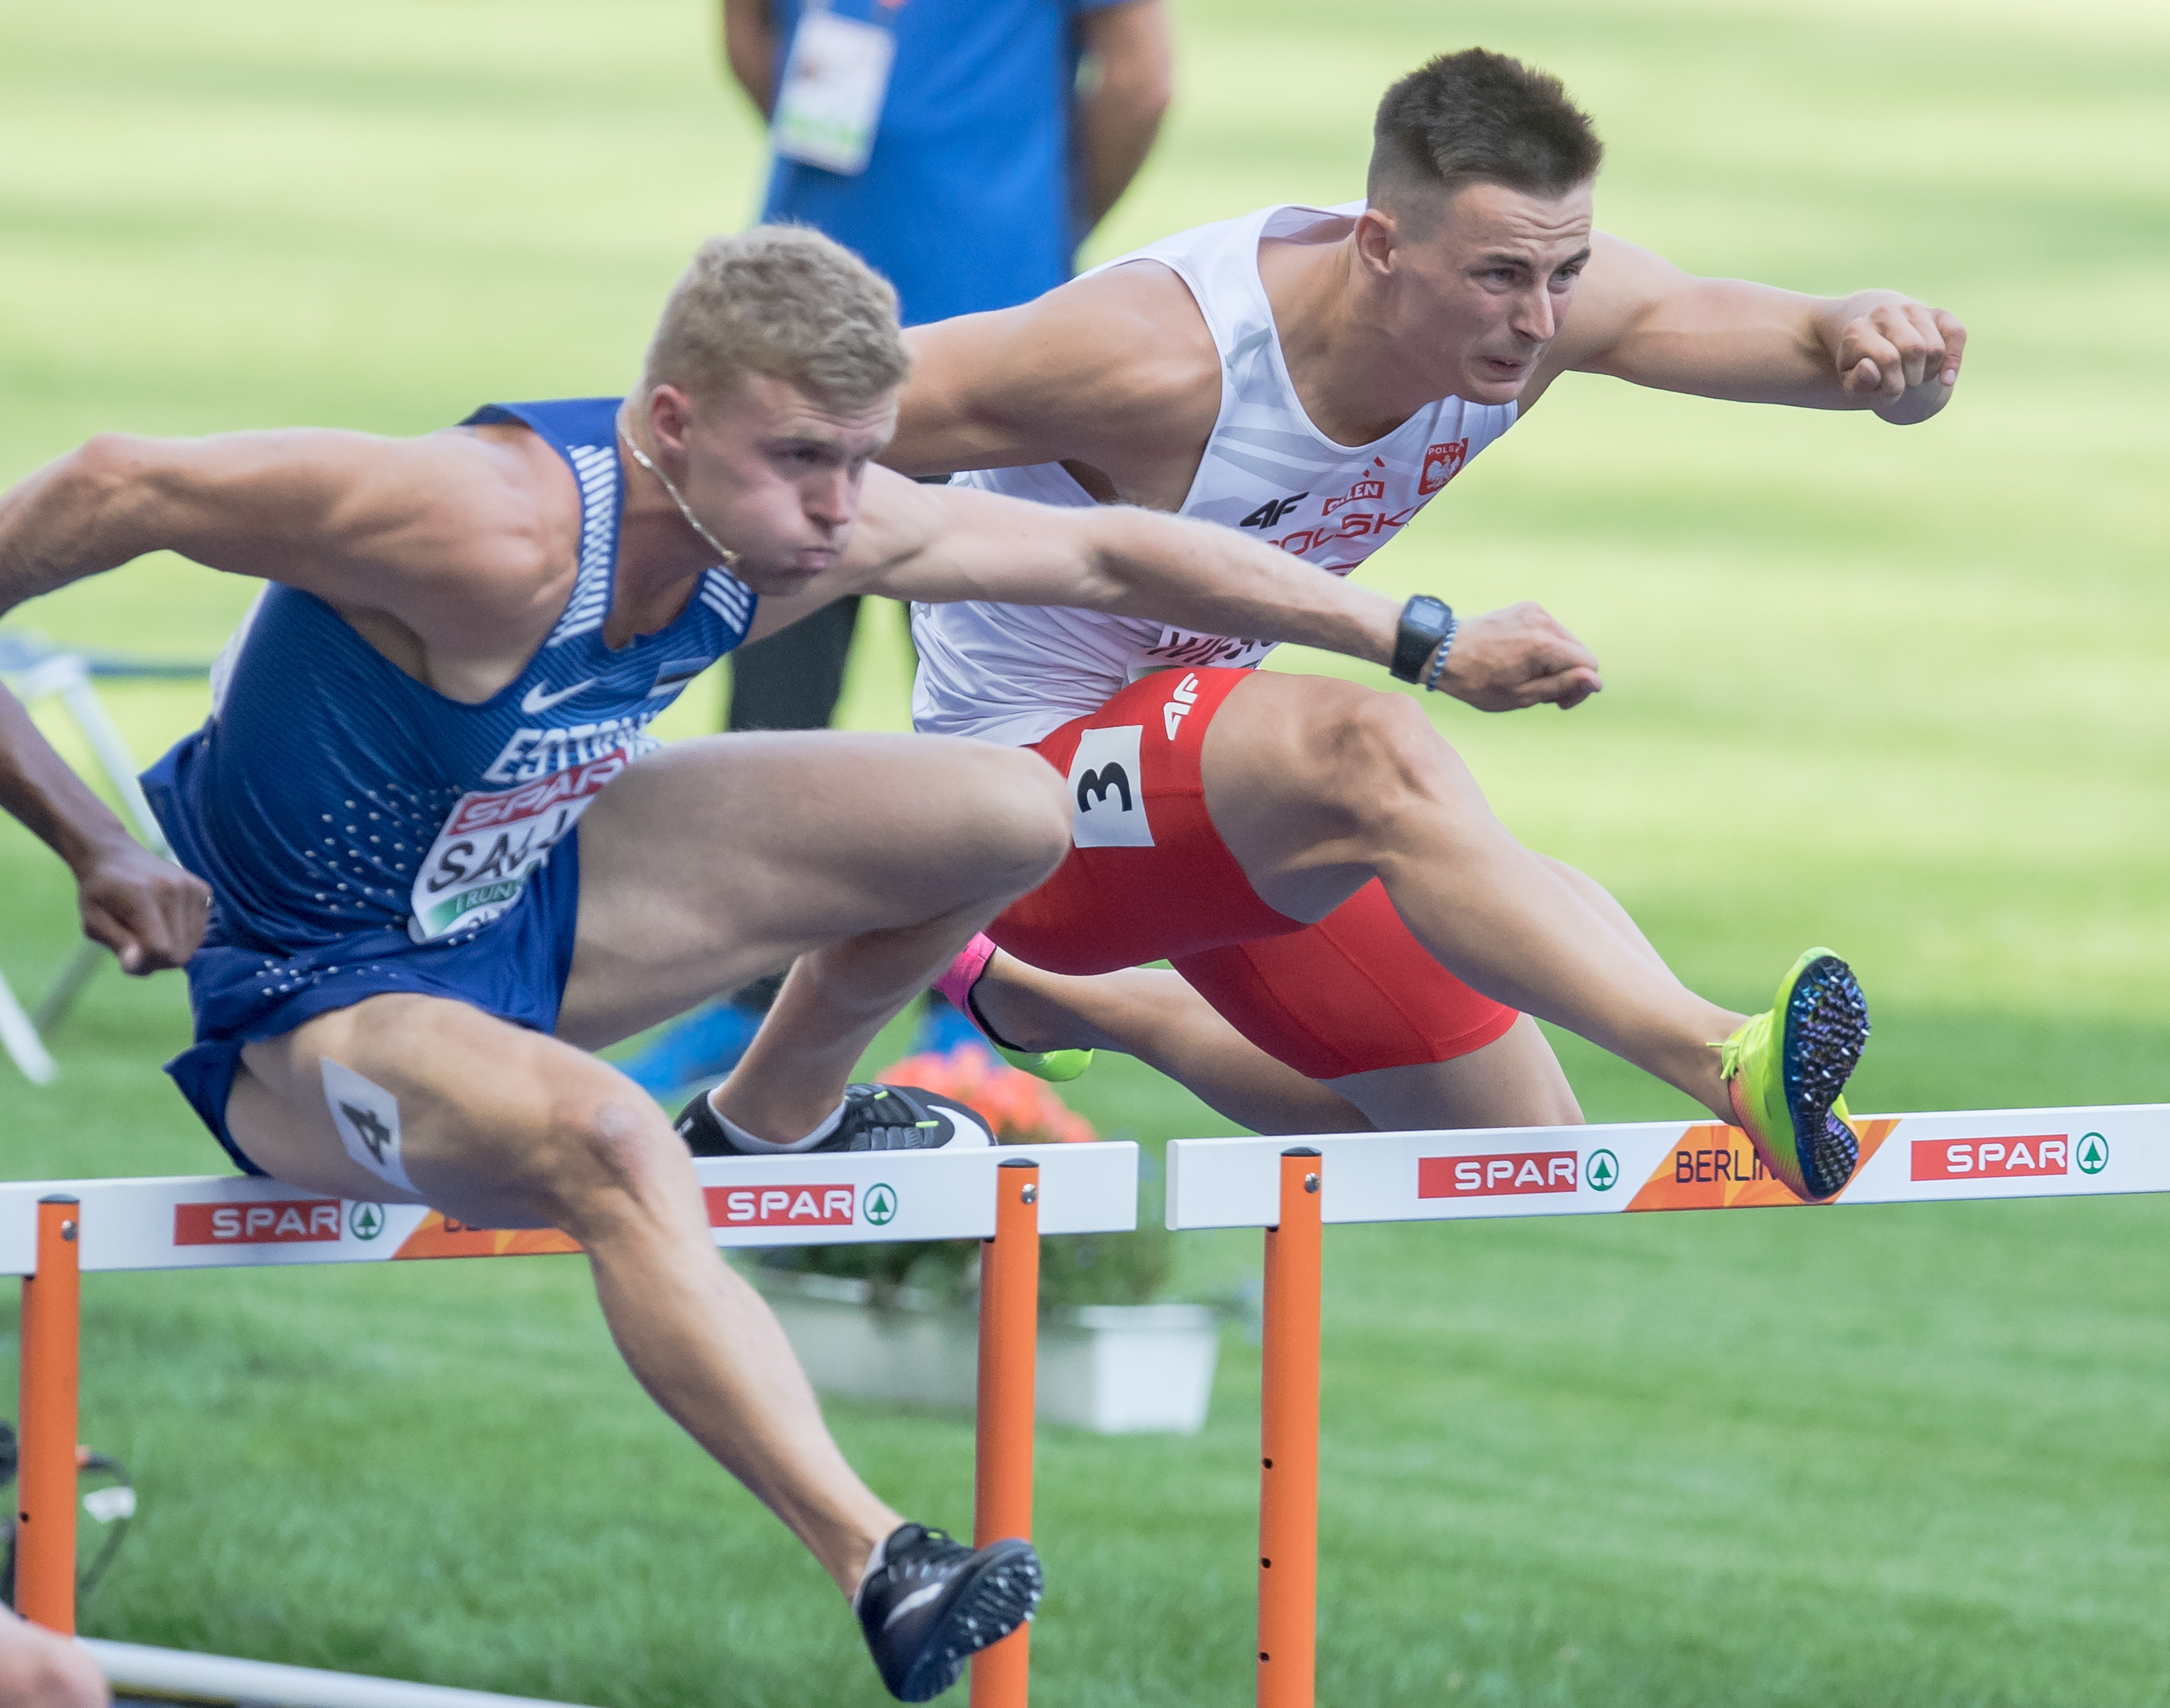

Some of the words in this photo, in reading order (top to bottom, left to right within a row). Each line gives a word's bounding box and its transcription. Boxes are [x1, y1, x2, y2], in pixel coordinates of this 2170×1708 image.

[1327, 483, 1380, 512] OLEN
[1265, 501, 1429, 555] OLSK
[455, 756, 625, 832] SPAR
[1076, 761, 1133, 813] 3
[340, 1099, 391, 1166] 4
[1946, 1140, 2066, 1173] SPAR
[1454, 1157, 1576, 1191] SPAR
[211, 1206, 340, 1238] SPAR
[726, 1189, 853, 1221] SPAR
